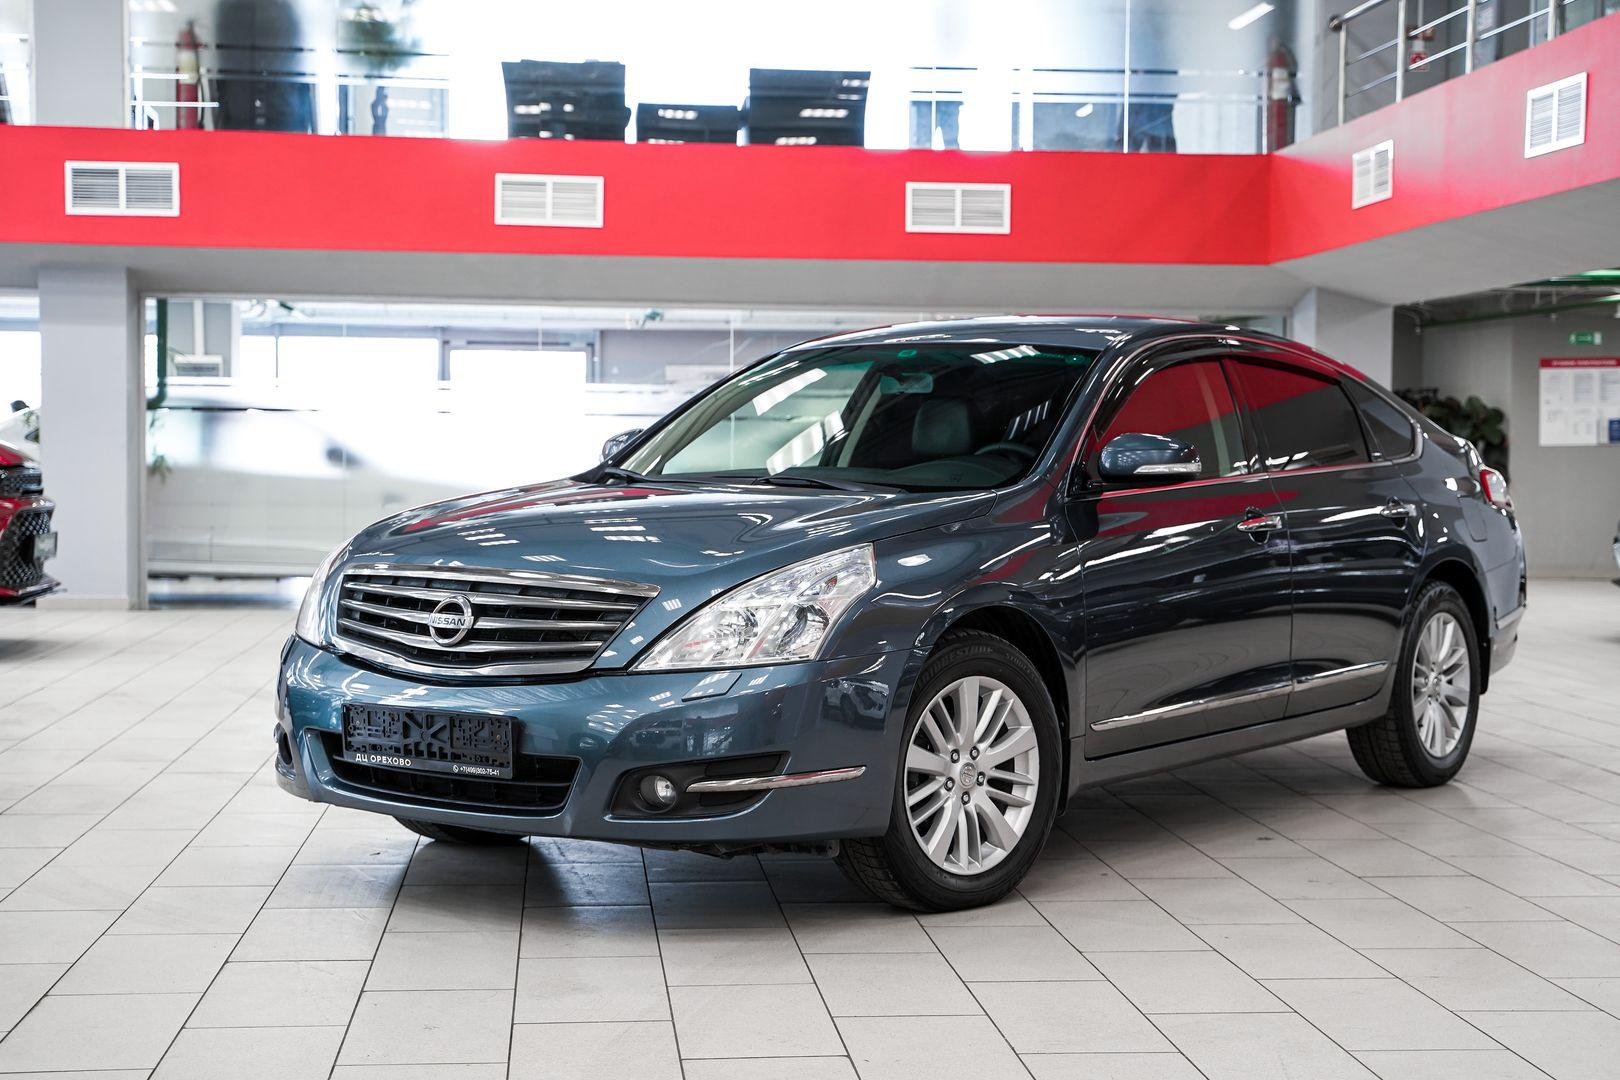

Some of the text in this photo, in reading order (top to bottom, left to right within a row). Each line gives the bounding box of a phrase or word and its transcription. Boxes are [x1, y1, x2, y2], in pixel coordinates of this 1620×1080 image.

[430, 615, 466, 626] NISSAN
[355, 753, 412, 767] ДЦ ОРЕХОВО
